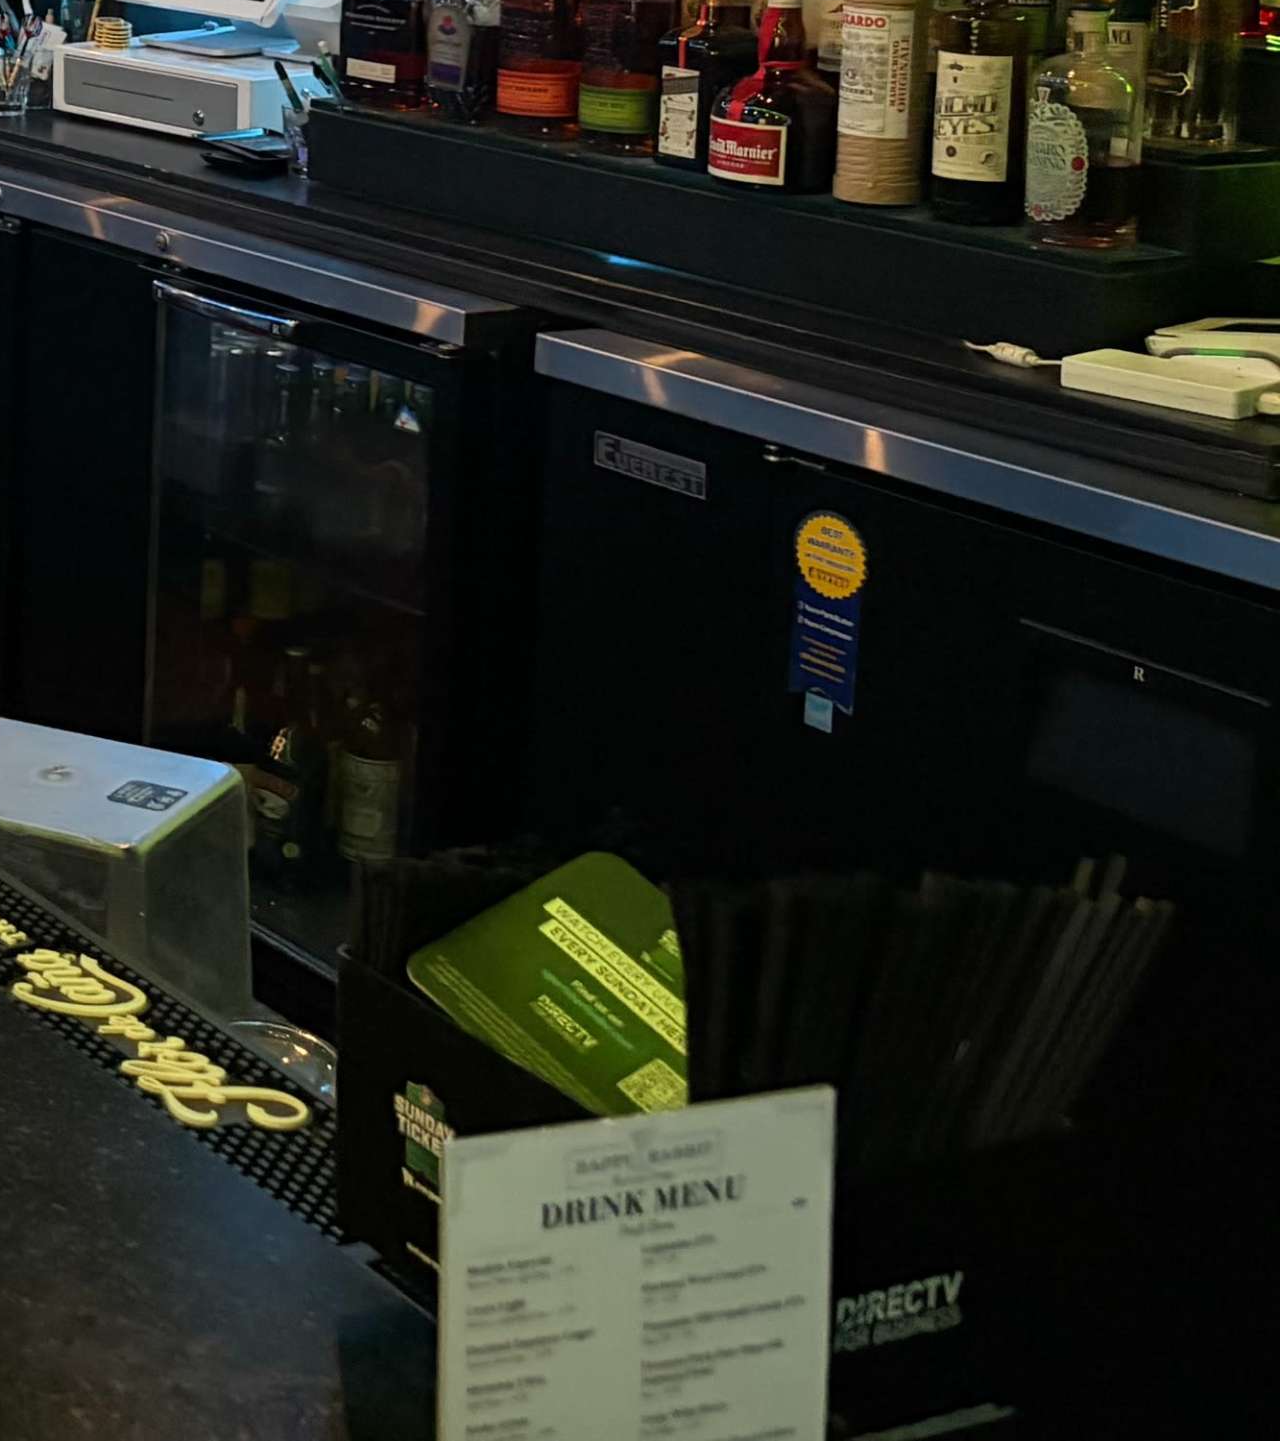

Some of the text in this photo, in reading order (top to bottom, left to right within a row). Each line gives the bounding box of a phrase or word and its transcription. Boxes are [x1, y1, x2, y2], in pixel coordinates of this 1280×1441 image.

[726, 141, 778, 160] Marnier
[597, 434, 704, 498] EVEREST
[548, 924, 597, 967] EVERY
[593, 962, 659, 1021] SUNDAY
[553, 903, 608, 953] WATCH
[605, 948, 654, 991] EVERY
[537, 995, 598, 1047] DIRECTV
[119, 1036, 312, 1131] Flor
[393, 1091, 455, 1141] SUNDAY
[396, 1113, 445, 1159] TICKE
[541, 1175, 747, 1229] DRINK MENU
[837, 1270, 964, 1325] DIRECTV
